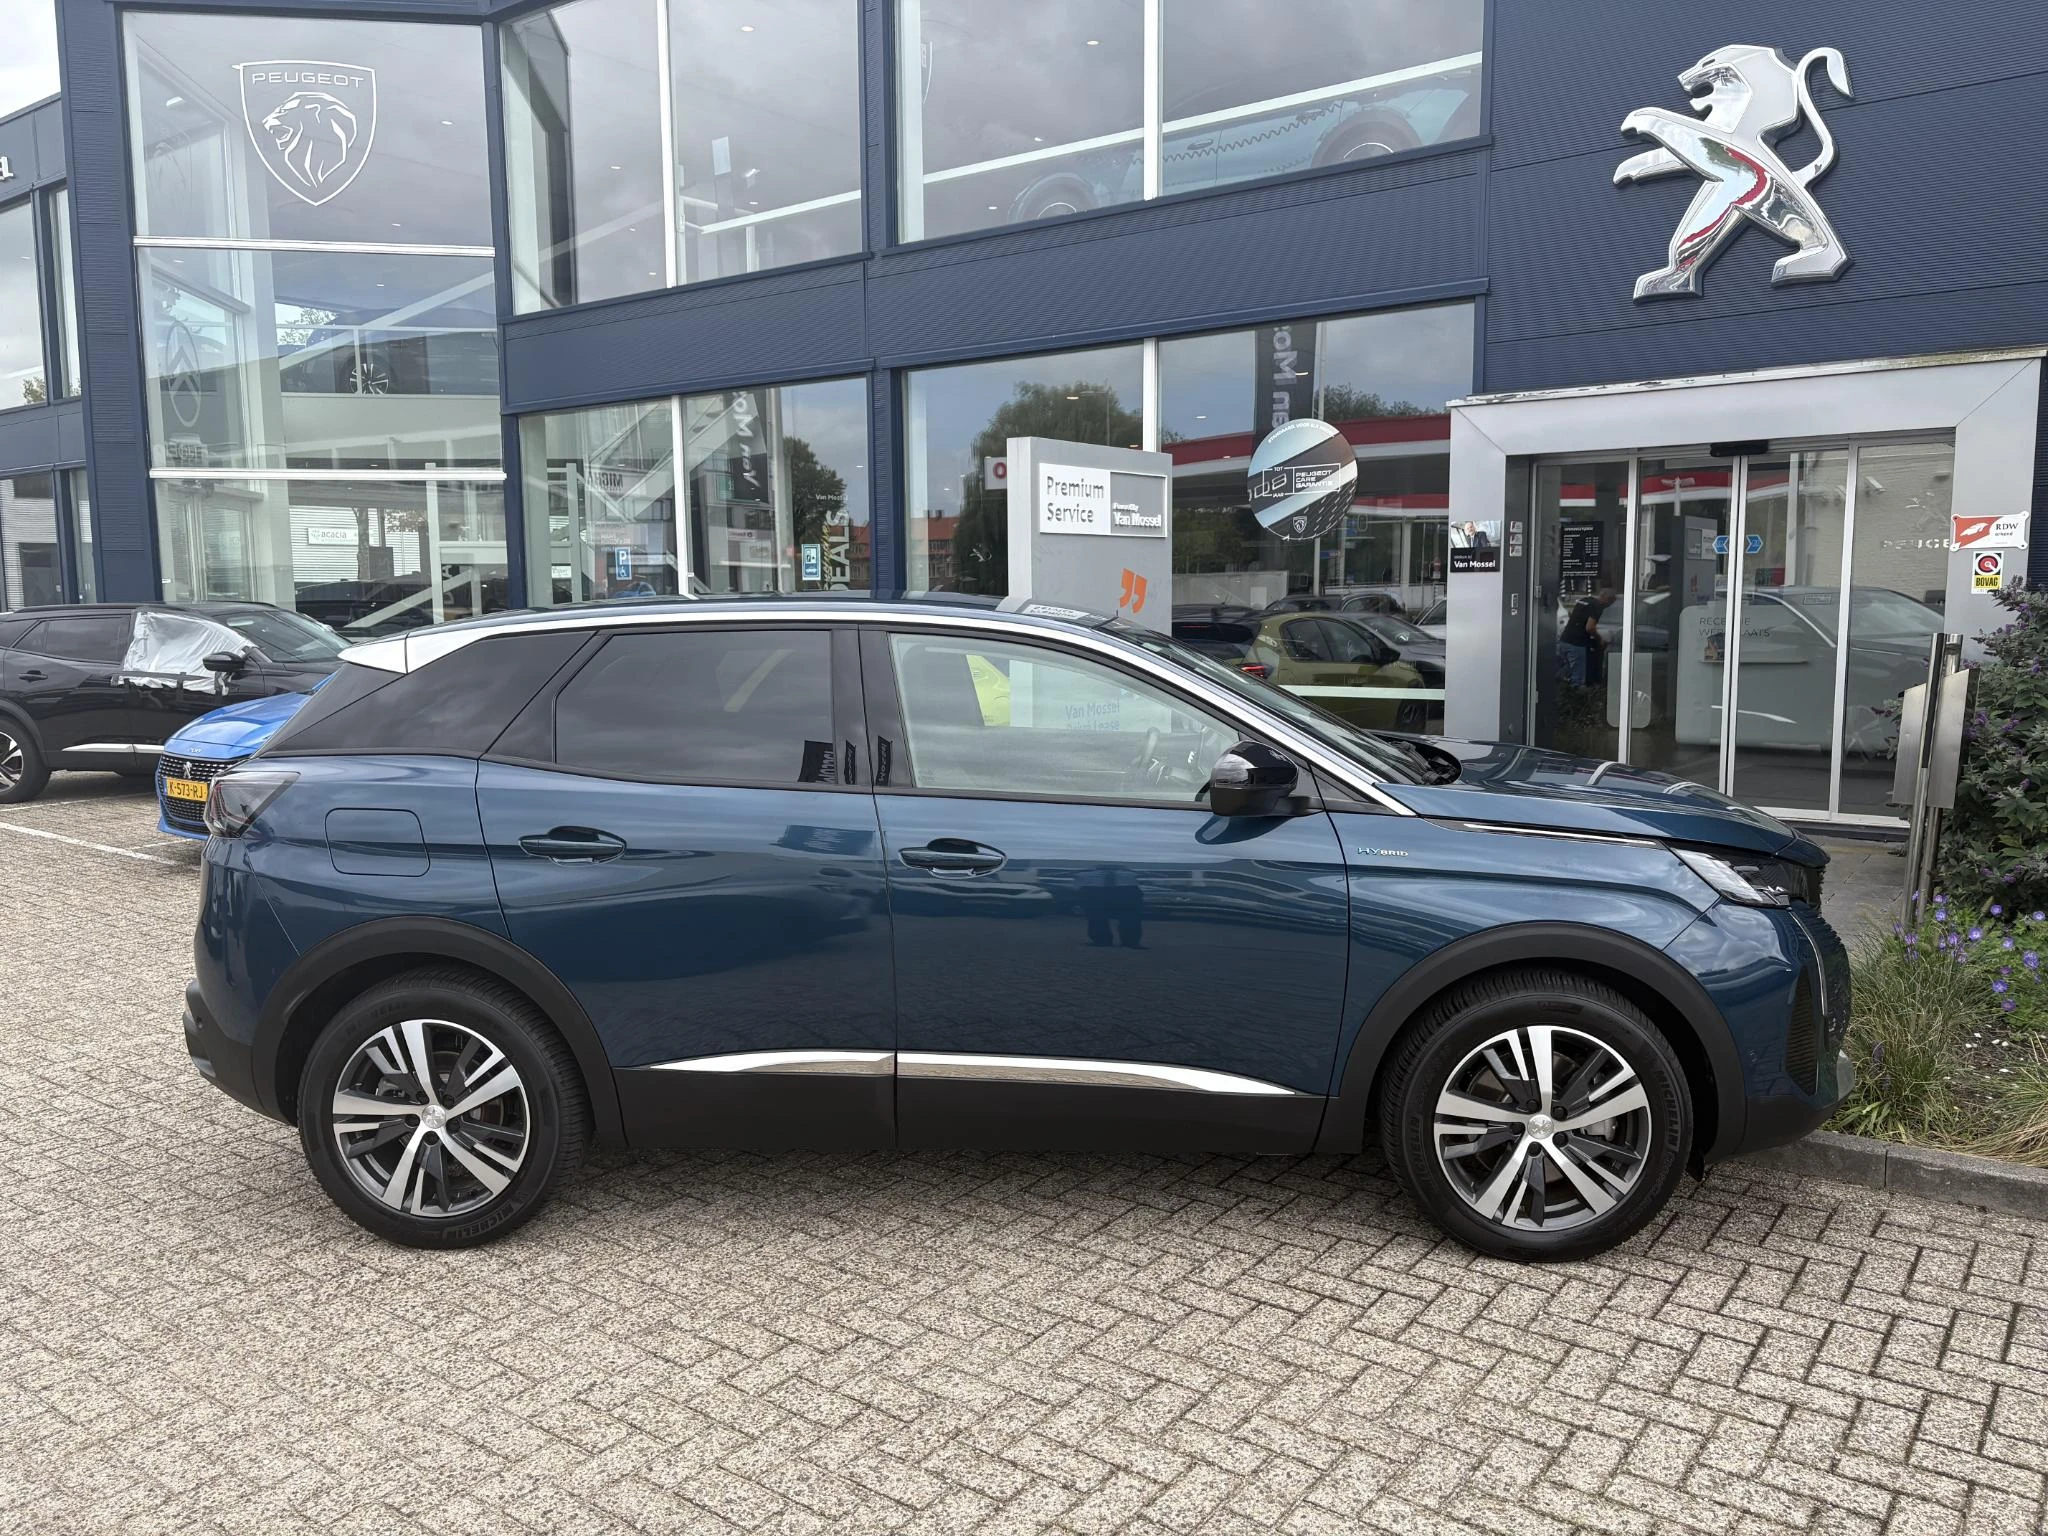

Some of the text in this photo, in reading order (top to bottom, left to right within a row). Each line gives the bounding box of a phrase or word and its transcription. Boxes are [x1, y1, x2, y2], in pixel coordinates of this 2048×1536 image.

[252, 71, 364, 88] PEUGEOT
[1046, 475, 1104, 499] Premium
[1046, 502, 1094, 523] Service
[1112, 511, 1162, 527] Van Mossel
[1995, 522, 2019, 530] RDW
[321, 531, 347, 539] acacia
[619, 550, 628, 566] P
[1453, 560, 1496, 568] Van Mossel
[1975, 576, 1999, 587] BOVAG
[1699, 617, 1751, 626] RECEIE
[169, 782, 203, 799] K-573-RJ
